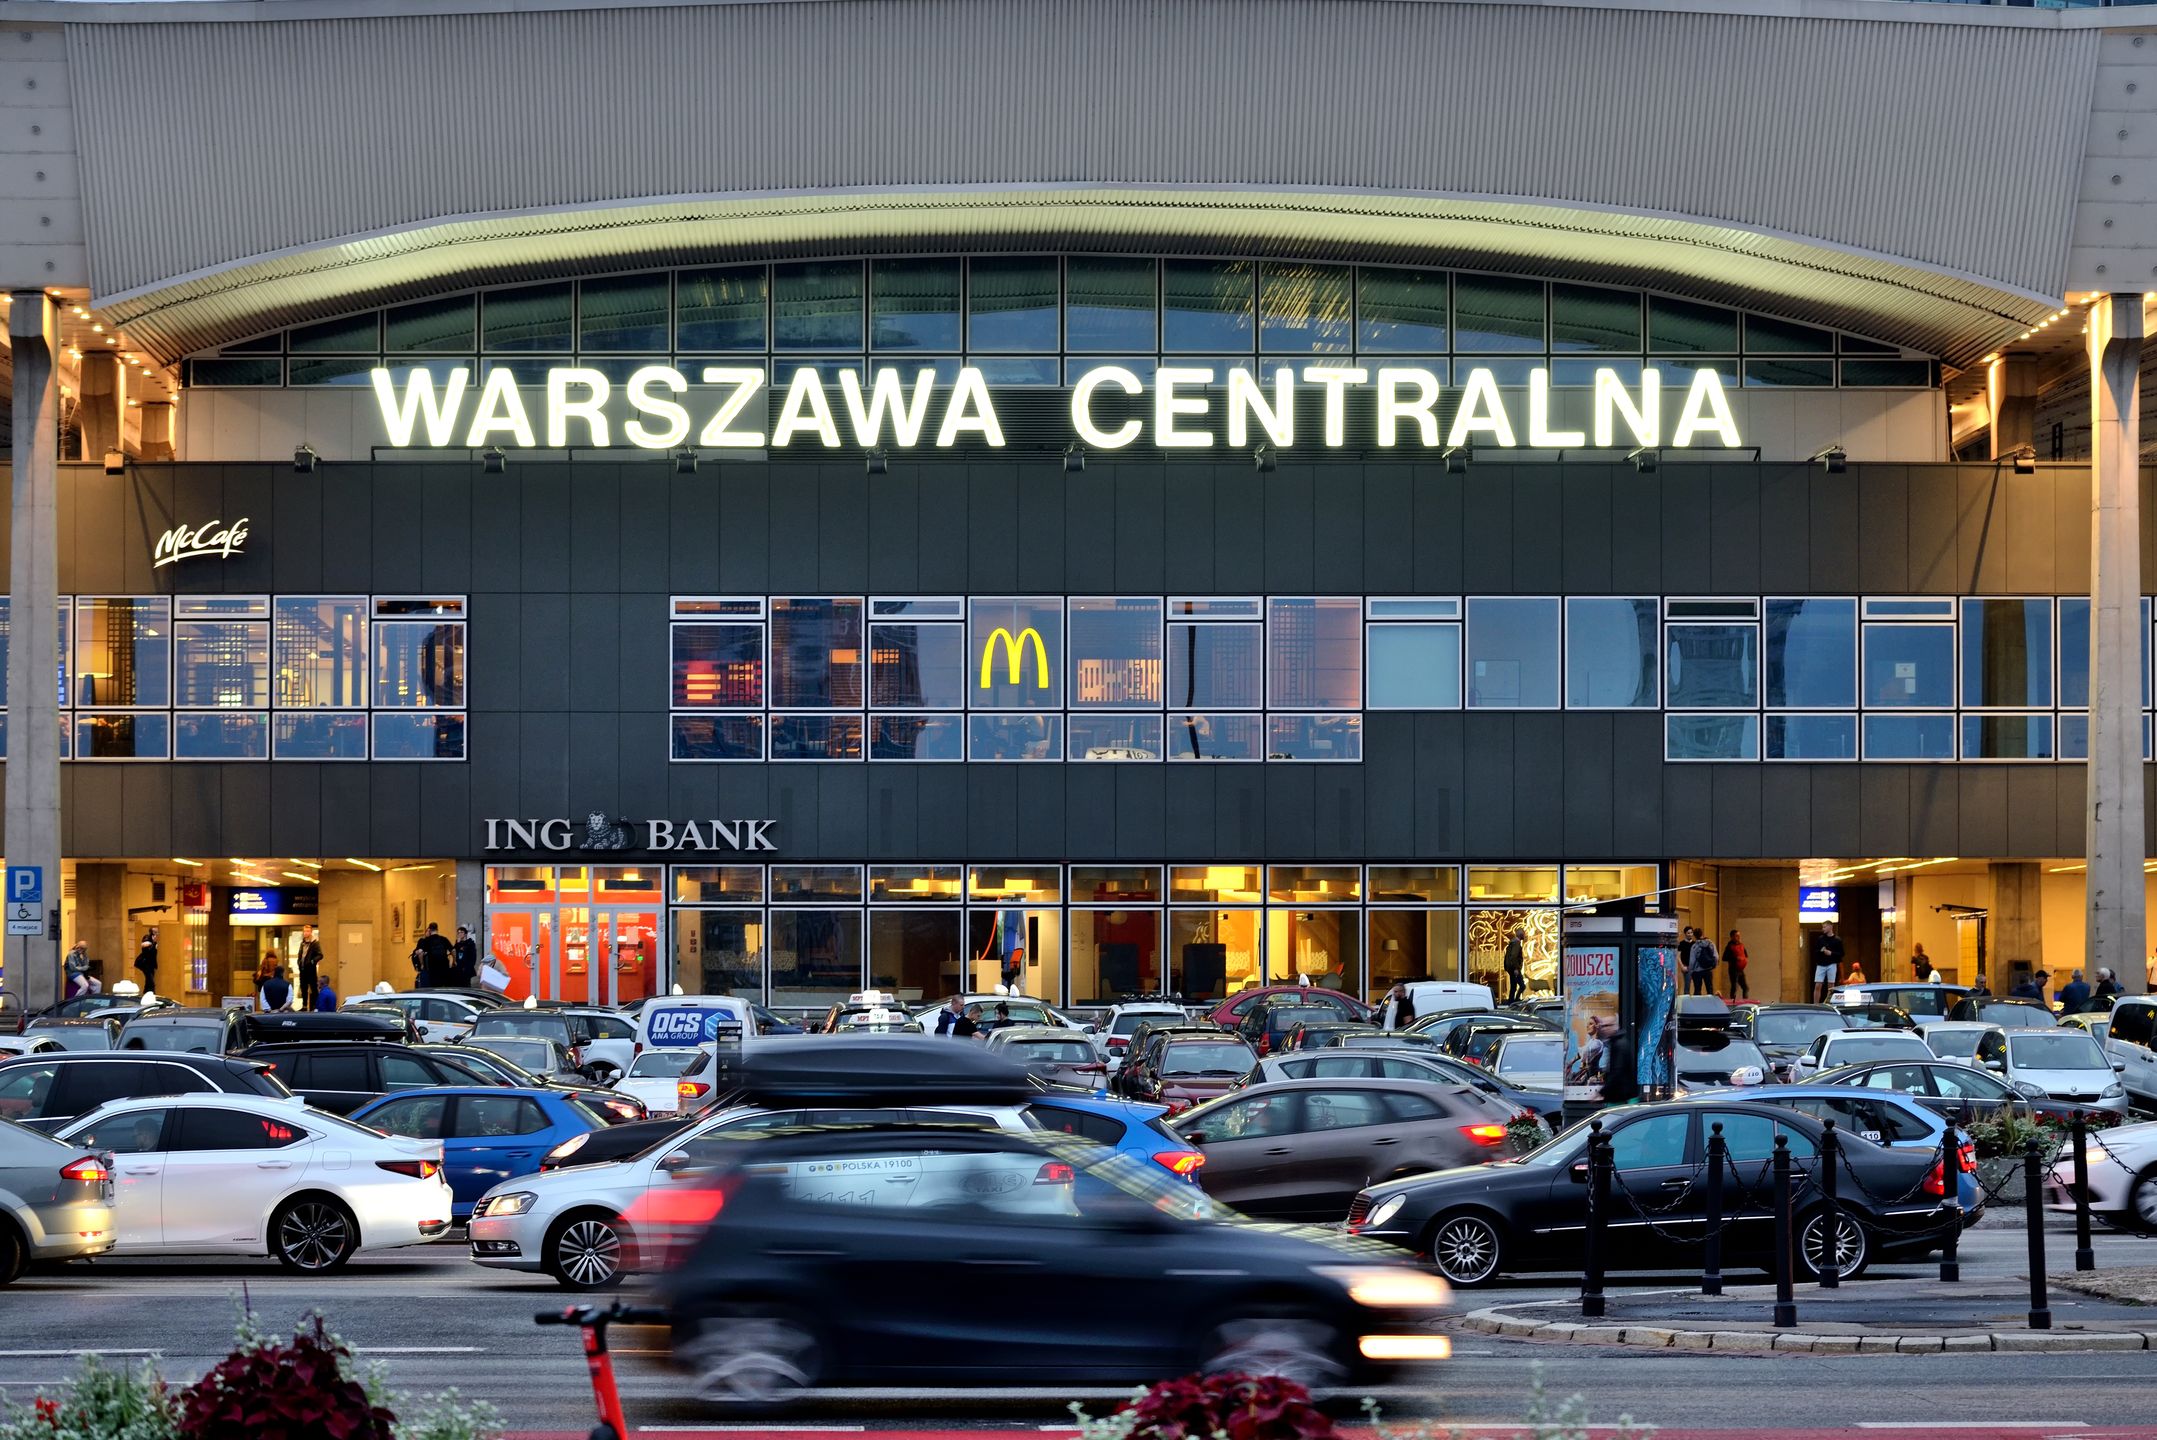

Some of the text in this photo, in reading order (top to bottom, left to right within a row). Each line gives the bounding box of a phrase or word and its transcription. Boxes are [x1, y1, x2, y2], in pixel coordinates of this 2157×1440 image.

[370, 364, 1743, 449] WARSZAWA CENTRALNA
[154, 517, 249, 565] McCafé
[484, 818, 778, 851] ING BANK
[15, 870, 35, 898] P
[652, 1012, 703, 1033] OCS
[651, 1032, 699, 1040] ANA GROUP
[842, 1161, 881, 1171] POLSKA
[884, 1159, 913, 1168] 19100
[976, 1185, 1004, 1193] TAXI
